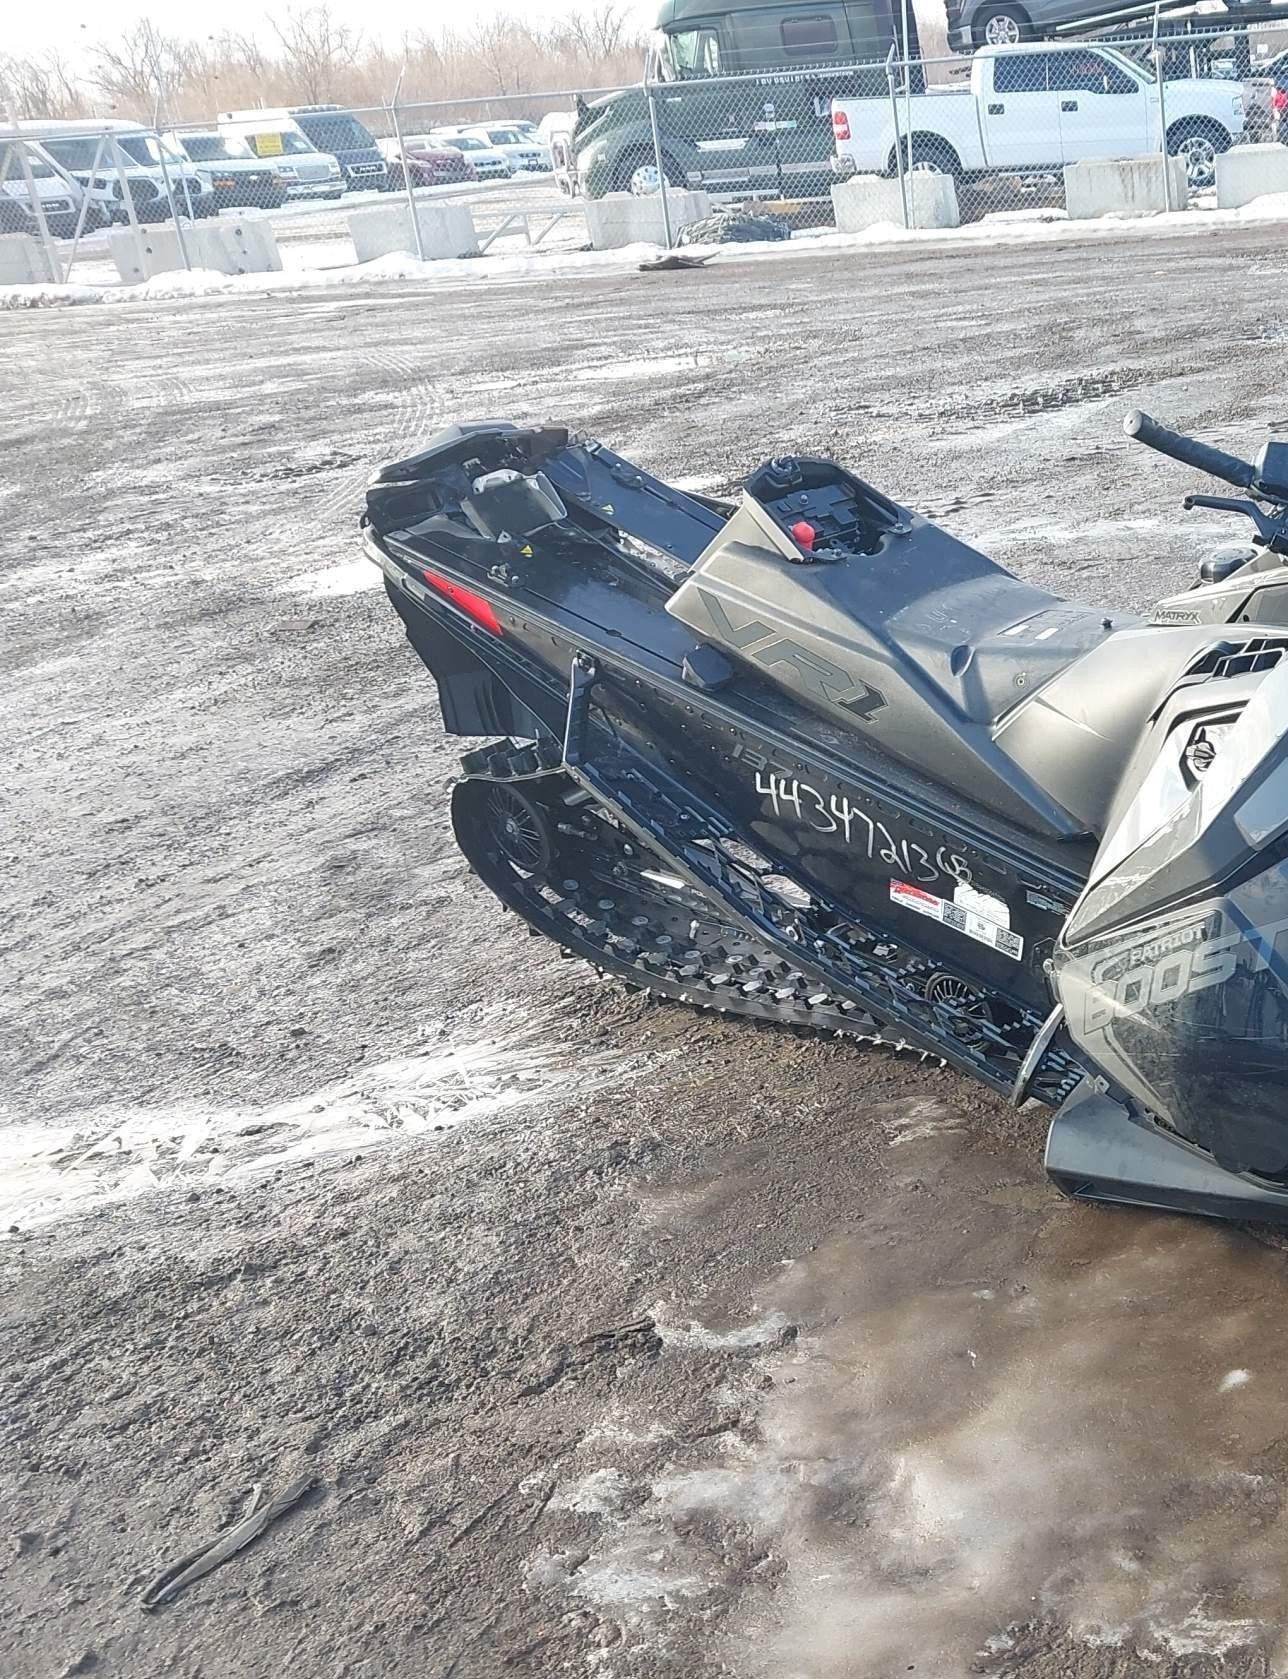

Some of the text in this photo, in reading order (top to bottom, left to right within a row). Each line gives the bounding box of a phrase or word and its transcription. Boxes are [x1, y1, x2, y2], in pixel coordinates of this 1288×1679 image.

[1154, 610, 1200, 622] MATRYX
[697, 587, 888, 724] VR1
[1130, 921, 1206, 965] PATRIOT
